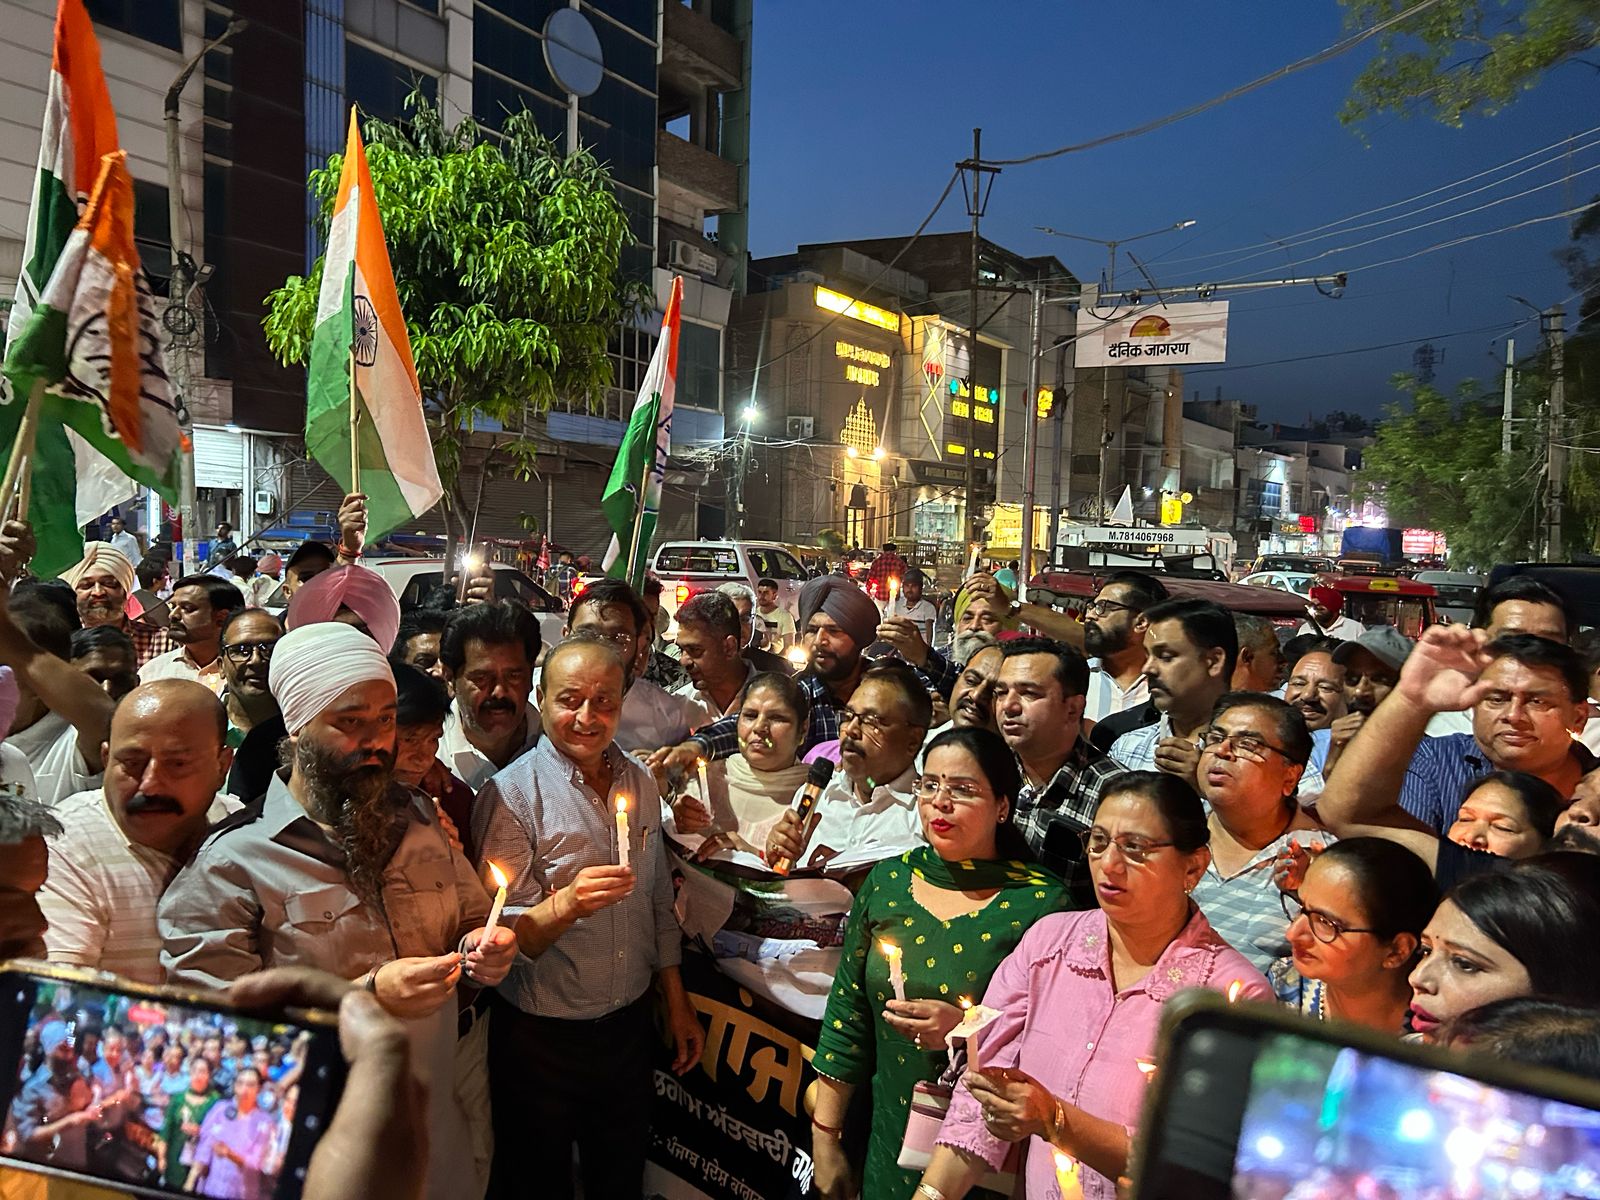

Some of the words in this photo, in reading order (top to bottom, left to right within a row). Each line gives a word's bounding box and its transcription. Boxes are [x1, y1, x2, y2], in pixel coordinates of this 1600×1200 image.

[1109, 341, 1142, 358] दैनिक
[1144, 342, 1190, 356] जागरण
[1108, 531, 1174, 542] M.7814067968
[653, 1069, 702, 1120] ਲਗਾਮ
[666, 1136, 700, 1168] ਪੰਜਾਬ
